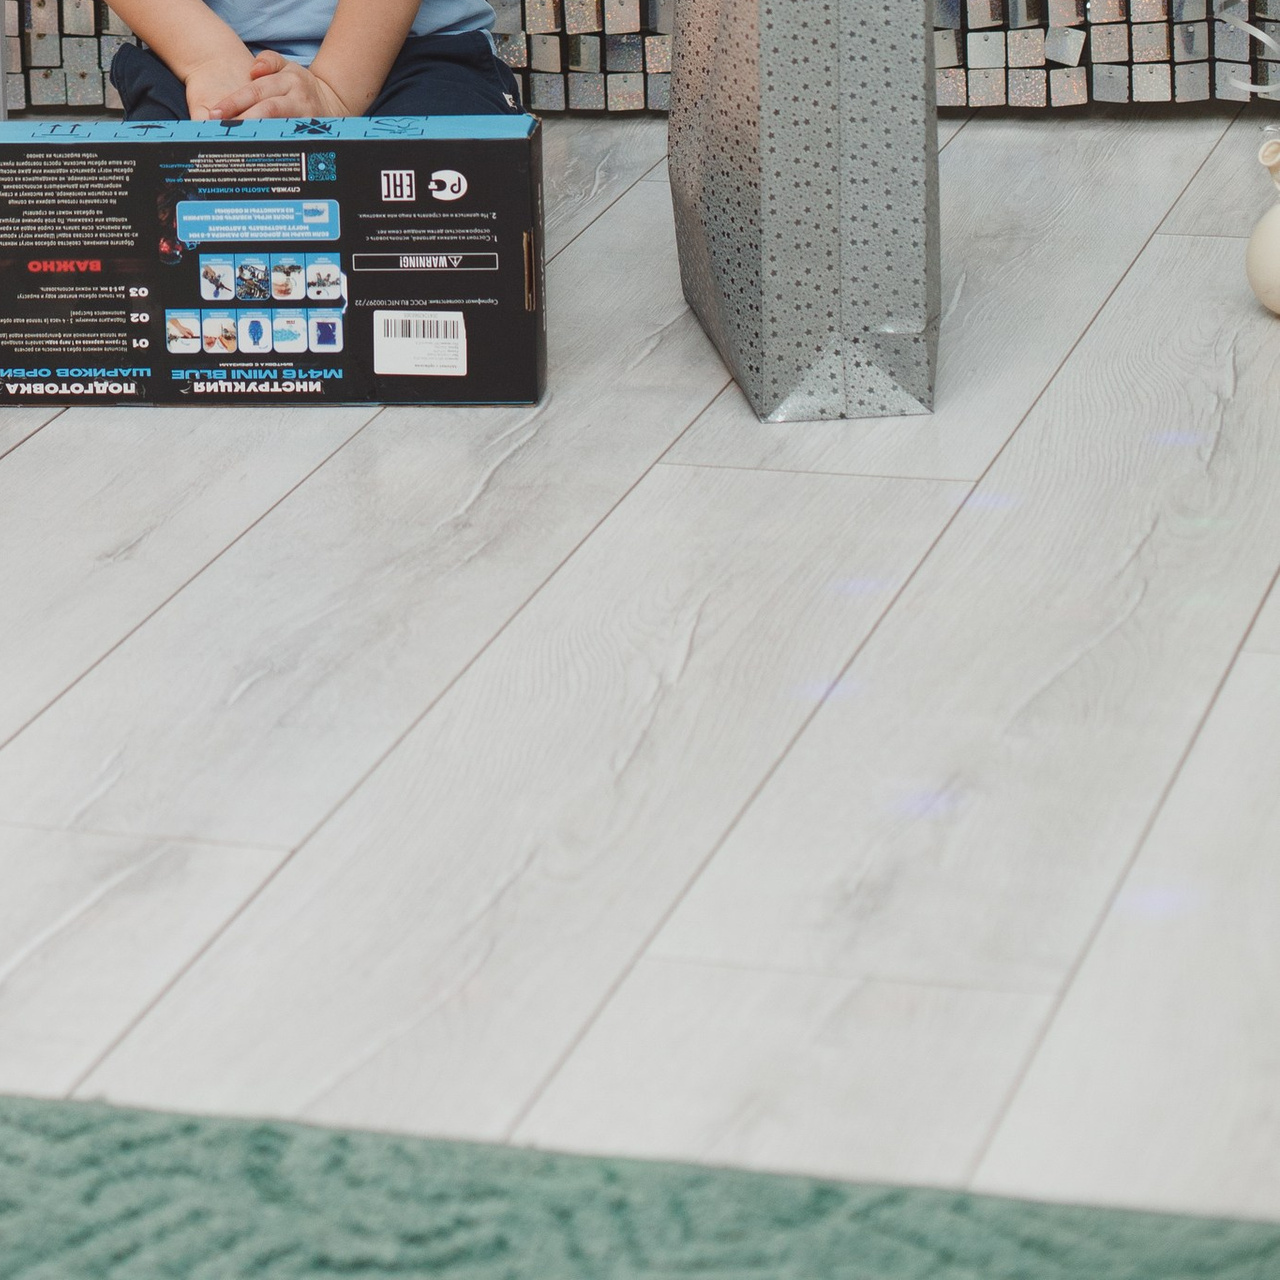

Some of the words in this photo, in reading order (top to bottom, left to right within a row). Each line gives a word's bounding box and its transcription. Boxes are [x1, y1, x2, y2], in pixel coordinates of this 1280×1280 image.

[28, 260, 102, 272] ВАЖНО
[399, 256, 448, 268] WARNING!
[129, 287, 149, 297] 03
[130, 313, 150, 322] 02
[132, 339, 150, 348] 01
[56, 368, 151, 377] ШАРИКОВ
[171, 369, 226, 379] BLUE
[231, 369, 277, 378] MINI
[282, 369, 343, 378] M416
[6, 381, 136, 394] ПОДГОТОВКА
[193, 380, 321, 392] ИНСТРУКЦИЯ
